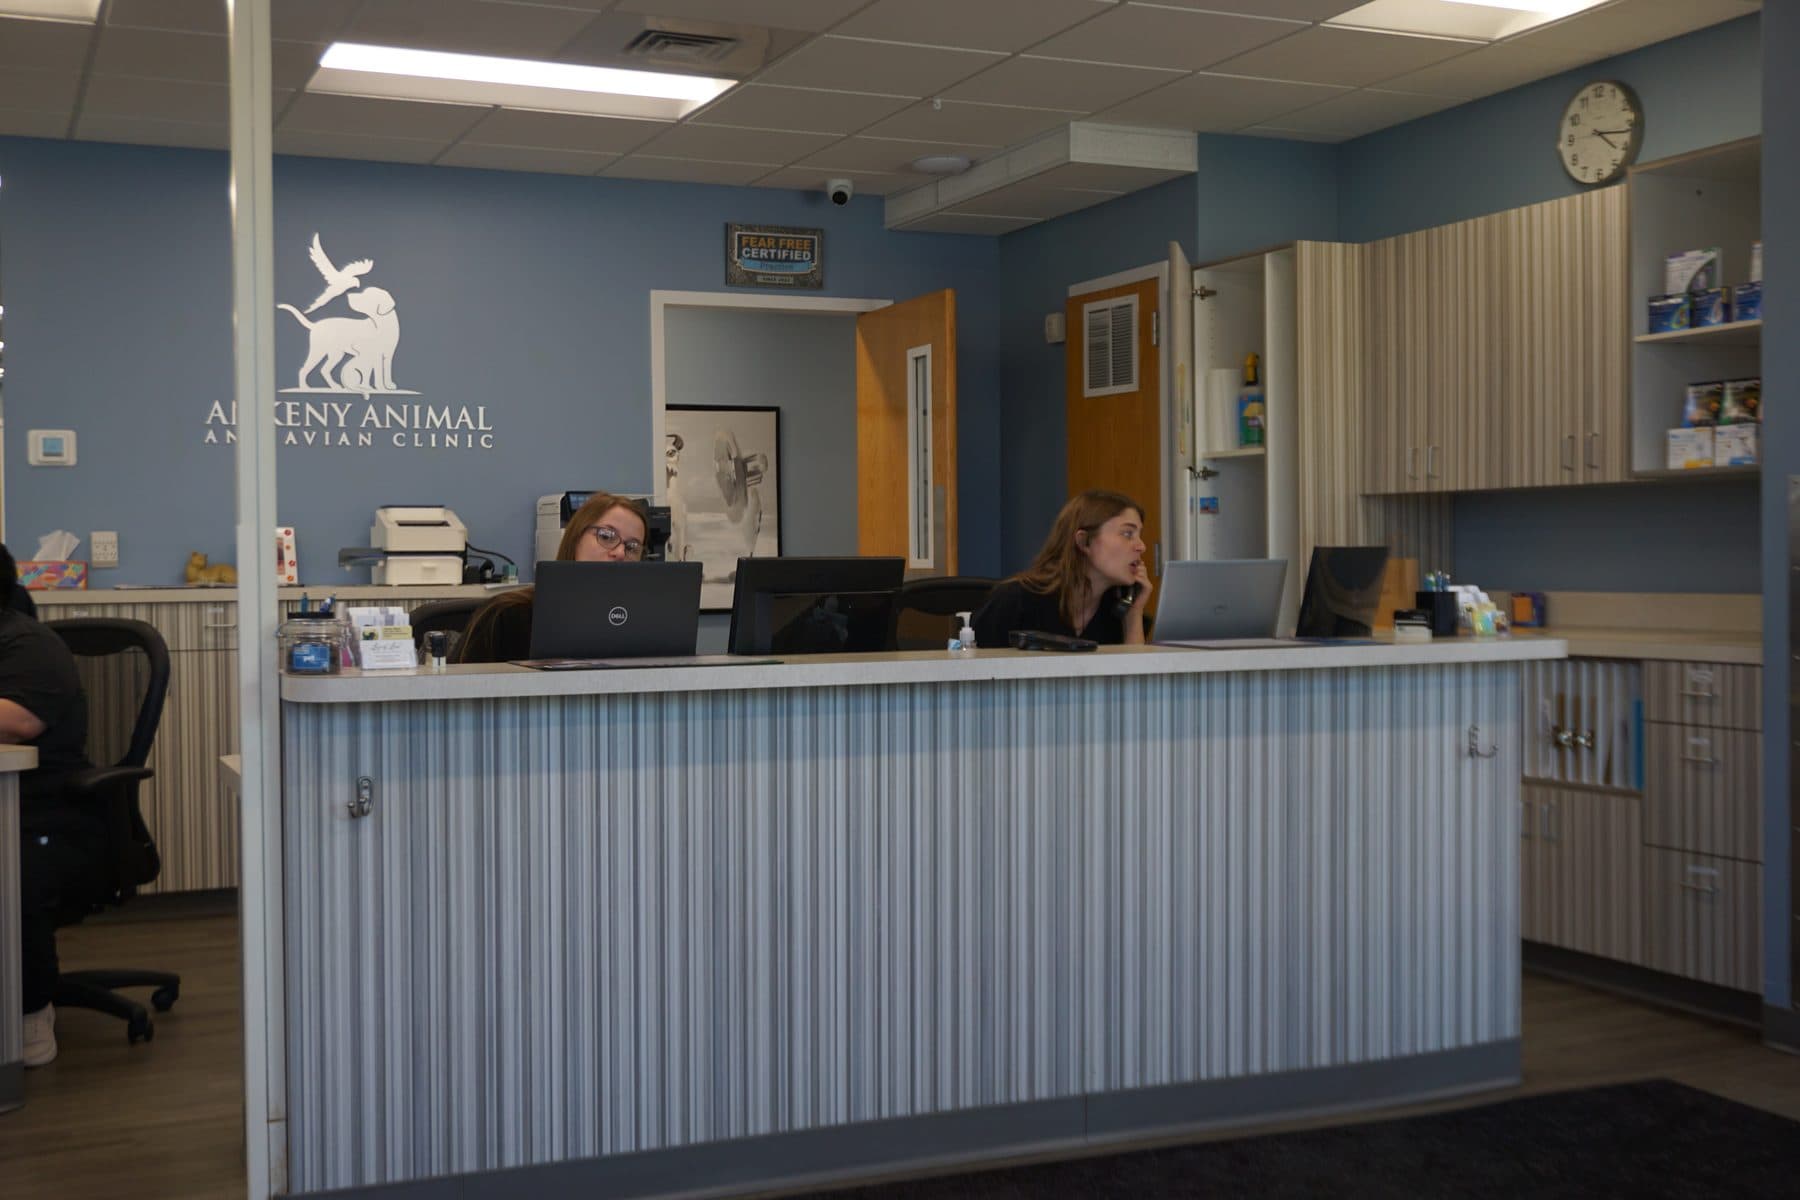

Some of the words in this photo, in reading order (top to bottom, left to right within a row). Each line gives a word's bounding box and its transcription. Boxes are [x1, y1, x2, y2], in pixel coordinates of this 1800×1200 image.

[741, 236, 775, 249] FEAR
[779, 239, 812, 250] FREE
[741, 248, 812, 261] CERTIFIED
[360, 404, 493, 431] ANIMAL
[284, 431, 373, 446] AVIAN
[393, 432, 494, 449] CLINIC
